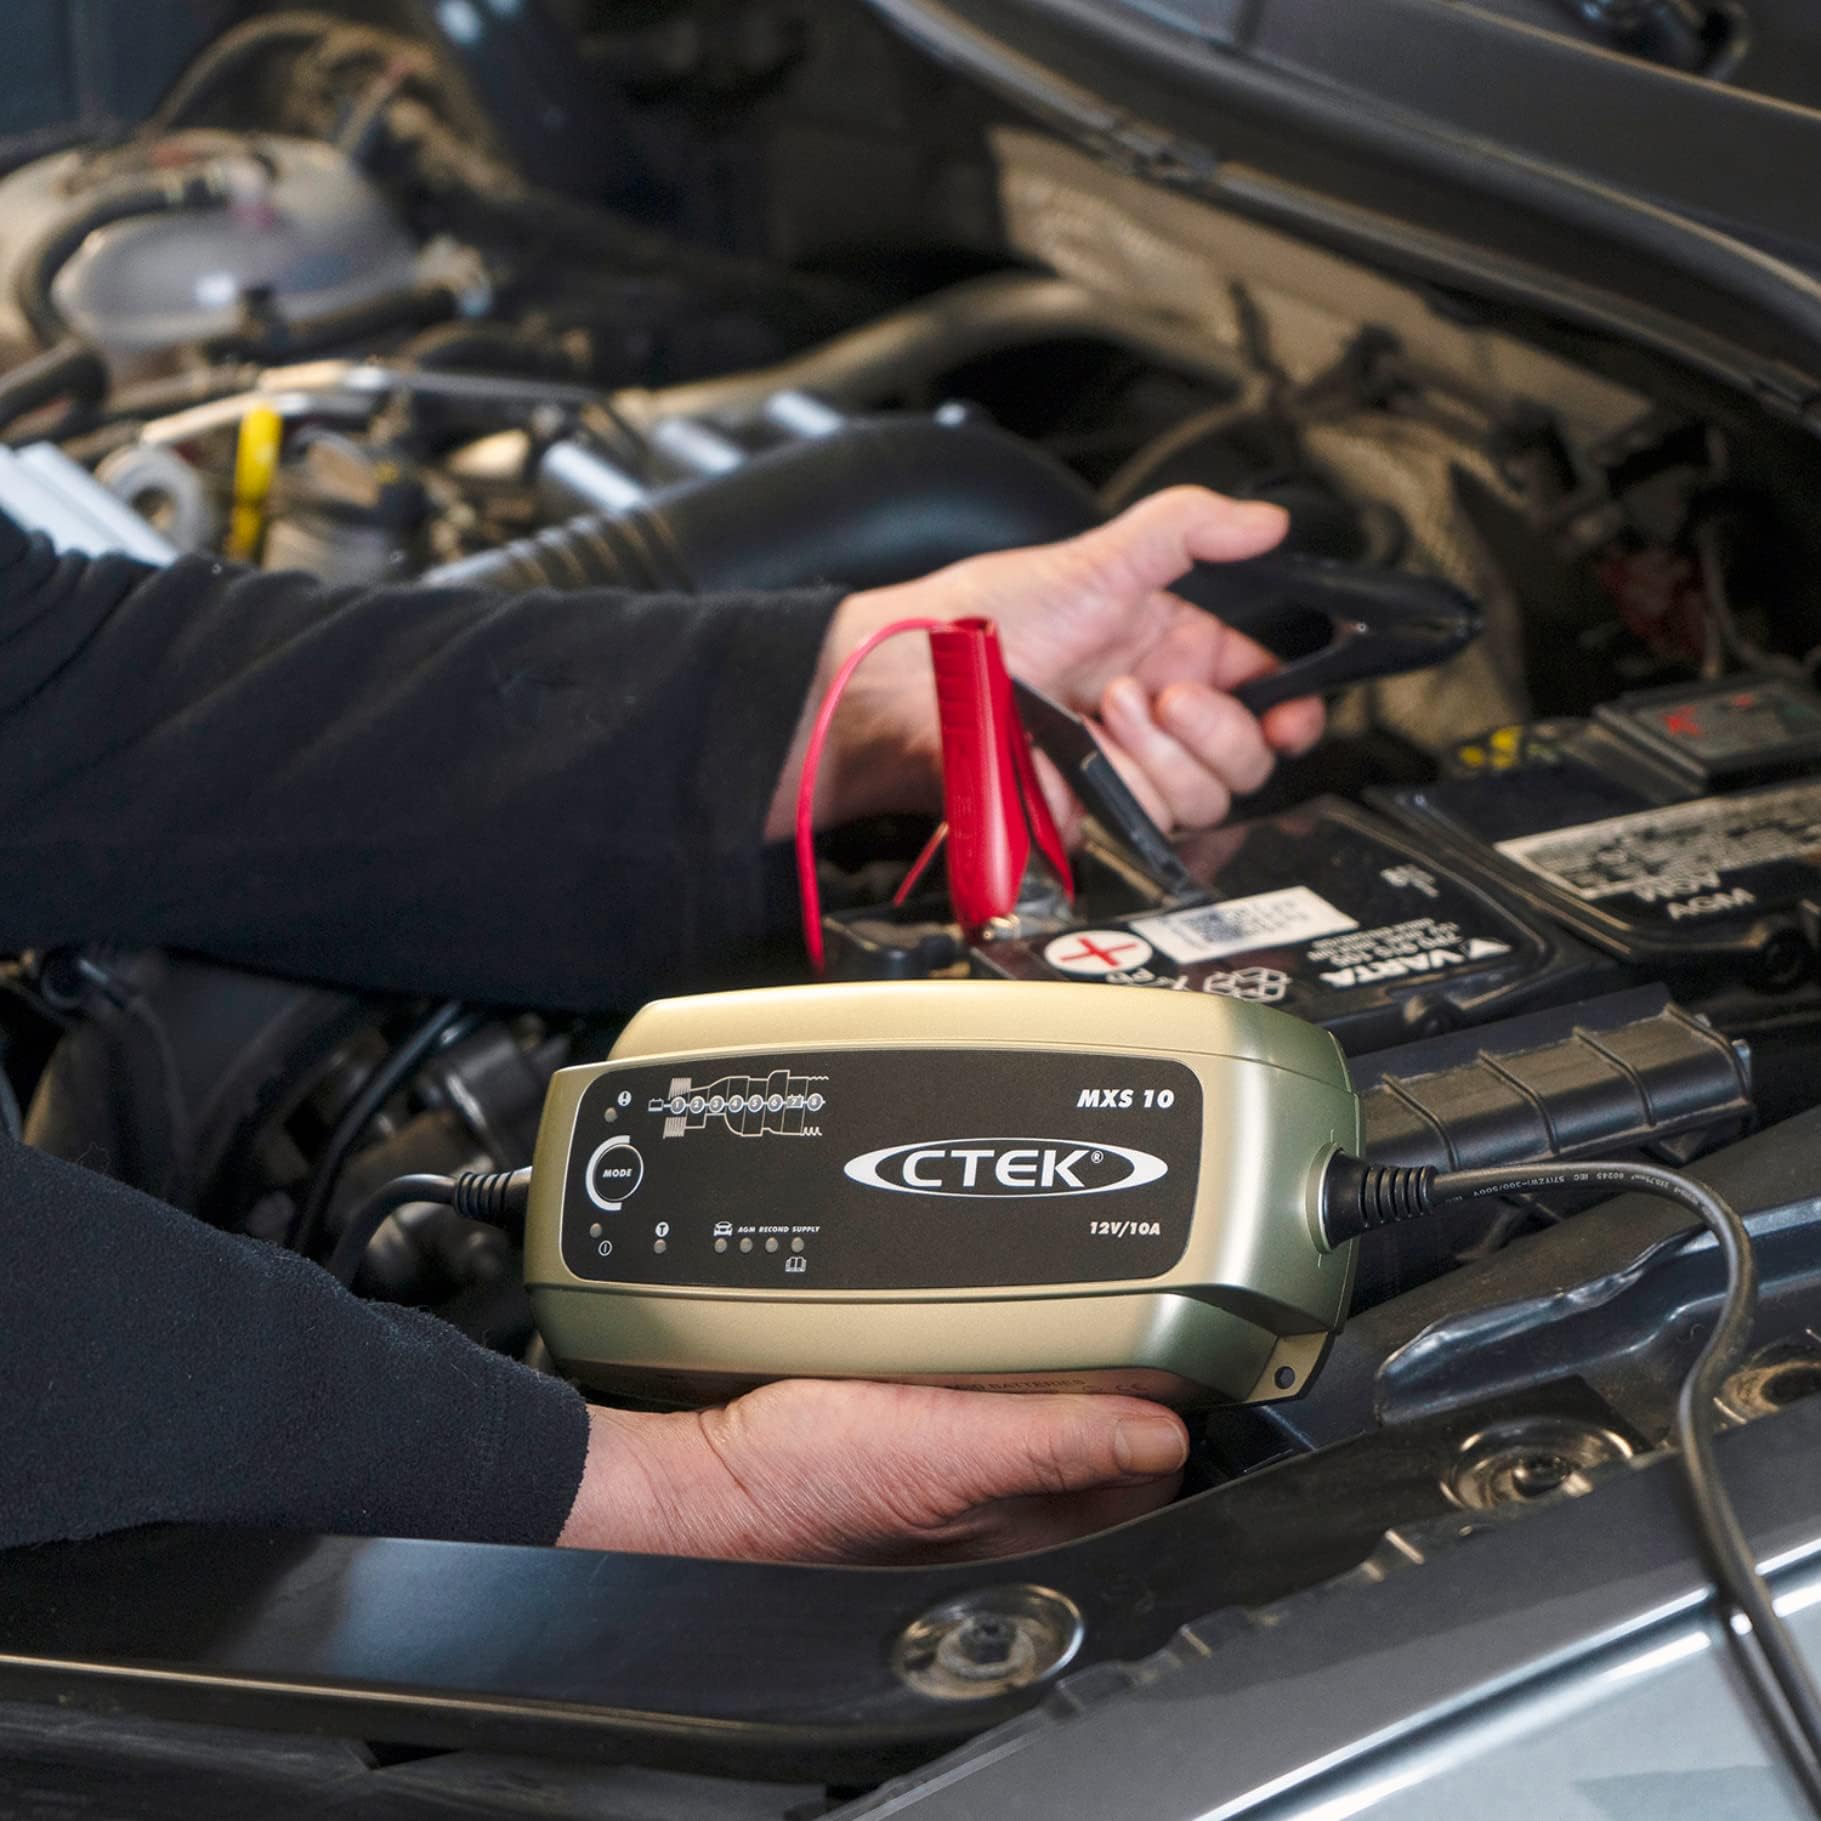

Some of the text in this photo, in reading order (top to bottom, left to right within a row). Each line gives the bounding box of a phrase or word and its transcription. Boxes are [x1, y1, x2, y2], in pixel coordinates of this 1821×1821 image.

[1319, 949, 1465, 988] VARTA
[1076, 1089, 1175, 1109] MXS 10
[602, 1168, 633, 1179] MODE
[737, 1225, 821, 1233] AGM RECOND SUPPLY
[1089, 1221, 1161, 1239] 12V/10A
